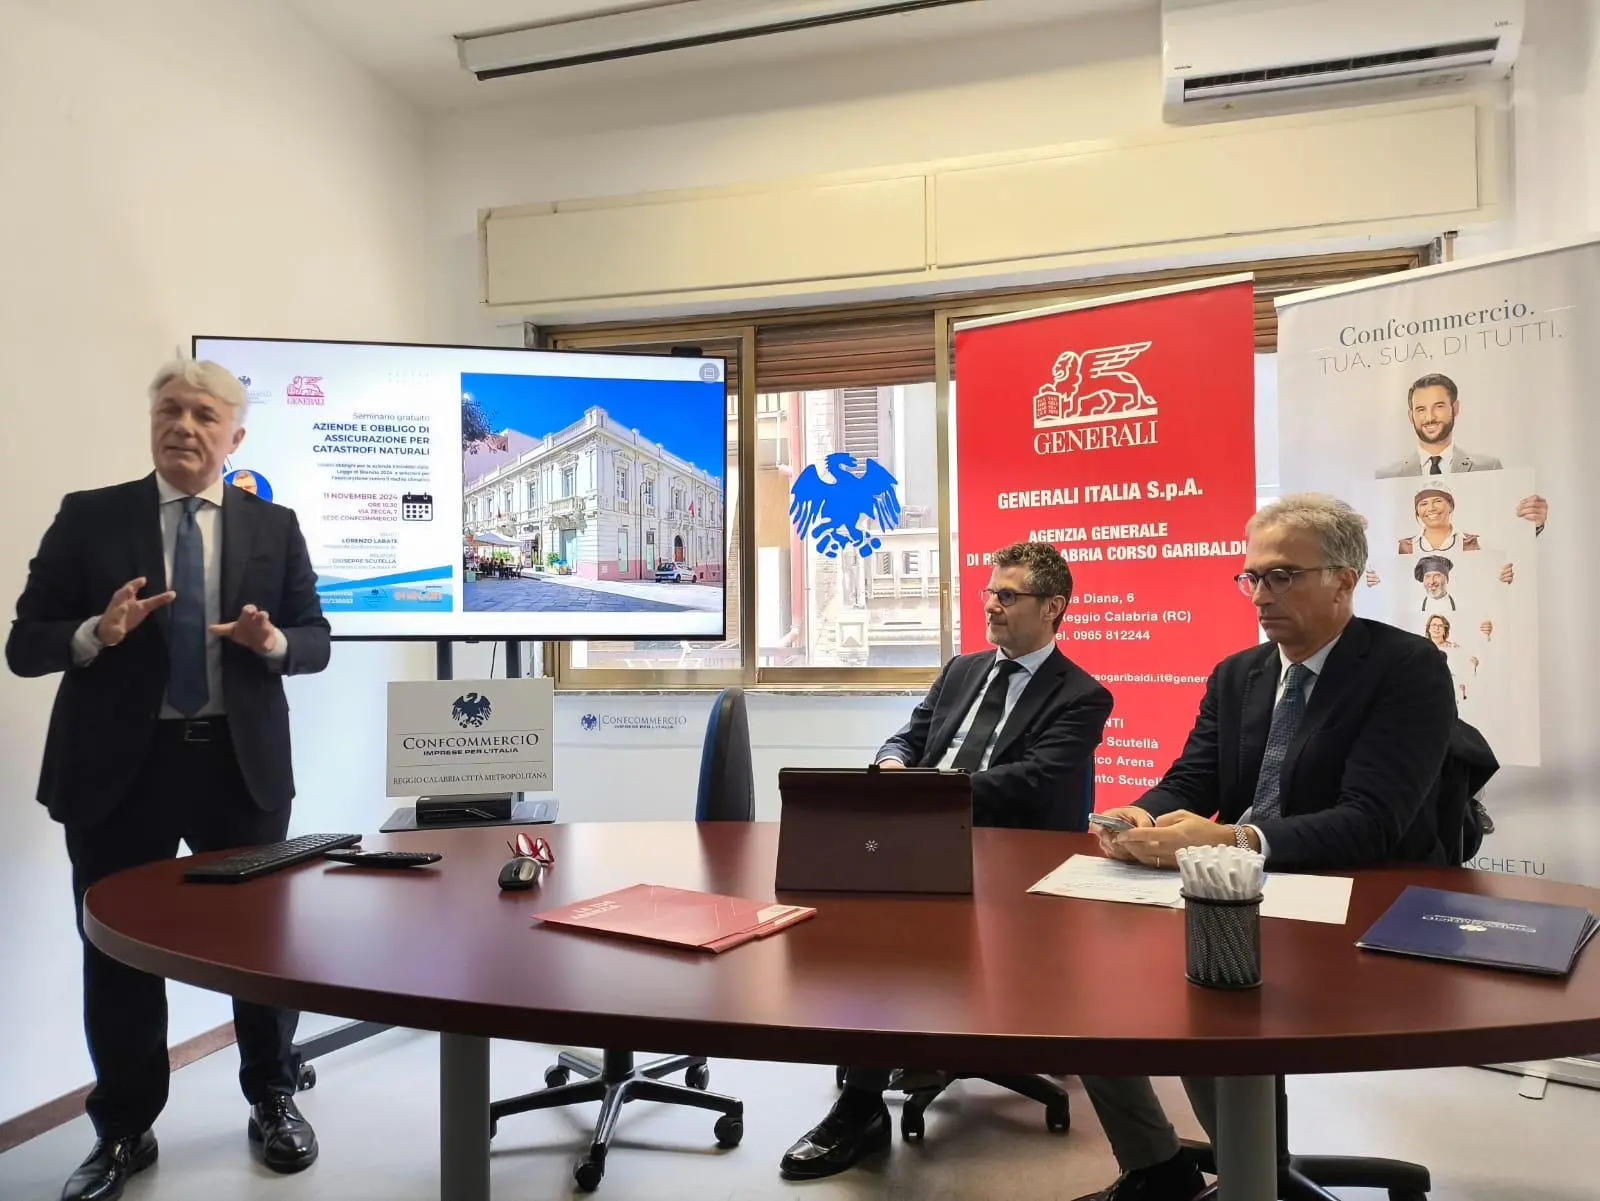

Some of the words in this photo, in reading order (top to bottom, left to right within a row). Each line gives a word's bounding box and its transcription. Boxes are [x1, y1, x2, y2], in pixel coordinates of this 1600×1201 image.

[1339, 299, 1535, 347] Confcommercio.
[1317, 352, 1371, 376] TUA.
[1379, 341, 1433, 367] SUA.
[1444, 334, 1468, 356] DI
[1478, 319, 1563, 351] TUTTI.
[287, 398, 325, 406] GENERALI
[353, 412, 395, 421] Seminario
[313, 422, 358, 432] AZIENDE
[361, 424, 367, 432] E
[369, 424, 416, 433] OBBLIGO
[419, 425, 430, 433] DI
[324, 434, 407, 444] ASSICURAZIONE
[410, 436, 430, 444] PER
[1033, 420, 1158, 455] GENERALI
[312, 445, 376, 454] CATASTROFI
[379, 447, 430, 455] NATURALI
[323, 492, 330, 500] 11
[331, 492, 377, 500] NOVEMBRE
[379, 493, 398, 501] 2024
[997, 488, 1079, 510] GENERALI
[1084, 483, 1141, 503] ITALIA
[1147, 478, 1203, 502] S.p.A.
[1028, 527, 1087, 543] AGENZIA
[1091, 522, 1168, 540] GENERALE
[966, 553, 979, 567] DI
[1060, 547, 1103, 563] ABRIA
[1107, 544, 1157, 561] CORSO
[1162, 539, 1248, 558] GARIBALDI
[1083, 593, 1123, 605] Diana,
[1126, 592, 1135, 603] 6
[1104, 611, 1158, 622] Calabria
[1163, 611, 1191, 623] (RC)
[1055, 630, 1070, 640] el.
[1073, 630, 1102, 640] 0965
[1105, 630, 1151, 640] 812244
[602, 715, 687, 726] CONFCOMMERCIO
[403, 733, 540, 750] CONFCOMMERCIO
[1106, 736, 1159, 749] Scutellà
[1116, 756, 1154, 768] Arena
[393, 777, 422, 785] REGGIO
[423, 775, 460, 783] CALABRIA
[484, 772, 547, 781] METROPOLITANA
[1462, 857, 1516, 873] NCHE
[1520, 860, 1545, 876] TU
